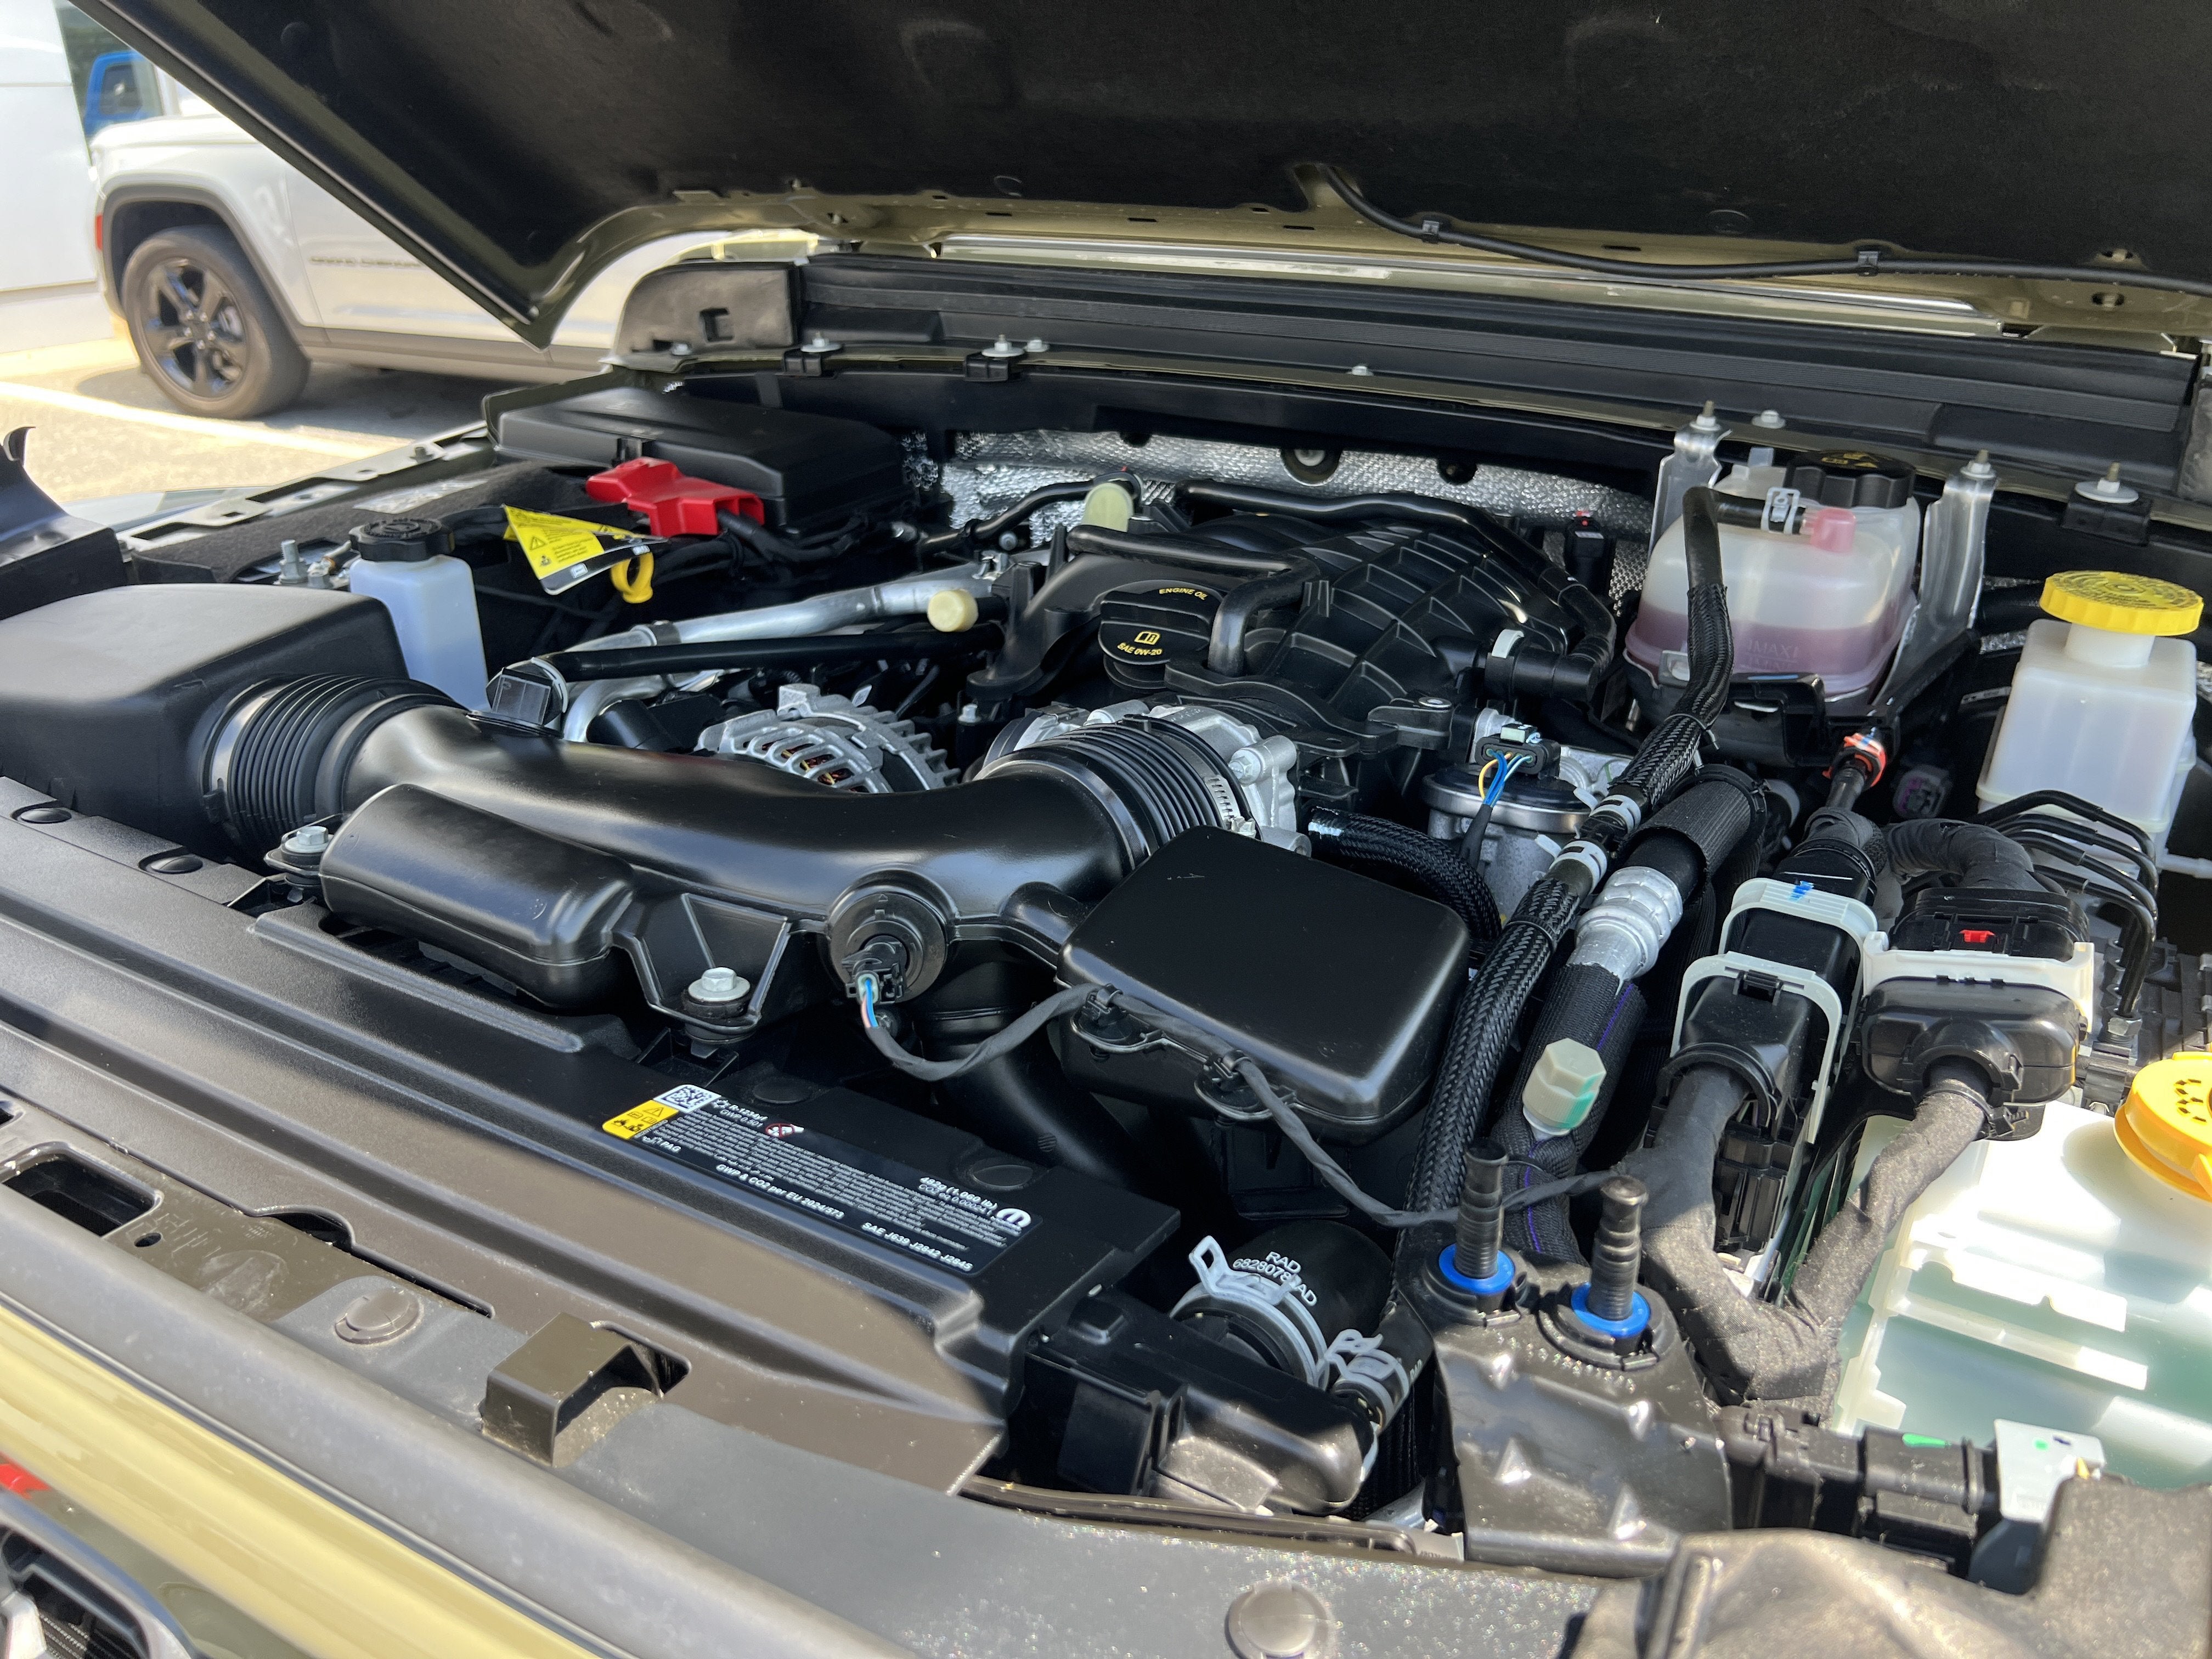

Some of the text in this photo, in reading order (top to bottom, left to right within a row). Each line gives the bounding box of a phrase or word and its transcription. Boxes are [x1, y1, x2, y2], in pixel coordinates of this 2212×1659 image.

[1194, 591, 1207, 601] OIL
[1116, 642, 1134, 653] SAE
[720, 1109, 742, 1120] GWP
[660, 1141, 681, 1153] PAG
[715, 1164, 741, 1177] GWP
[738, 1173, 749, 1182] &
[748, 1177, 771, 1190] CO2
[767, 1186, 787, 1197] per
[785, 1191, 803, 1203] EU
[800, 1198, 845, 1220] 2024/573
[918, 1184, 940, 1197] CO2
[861, 1222, 974, 1272] SAE J639 J2842 J2845
[1266, 1251, 1302, 1274] RAD
[1232, 1258, 1317, 1307] 6828078AD
